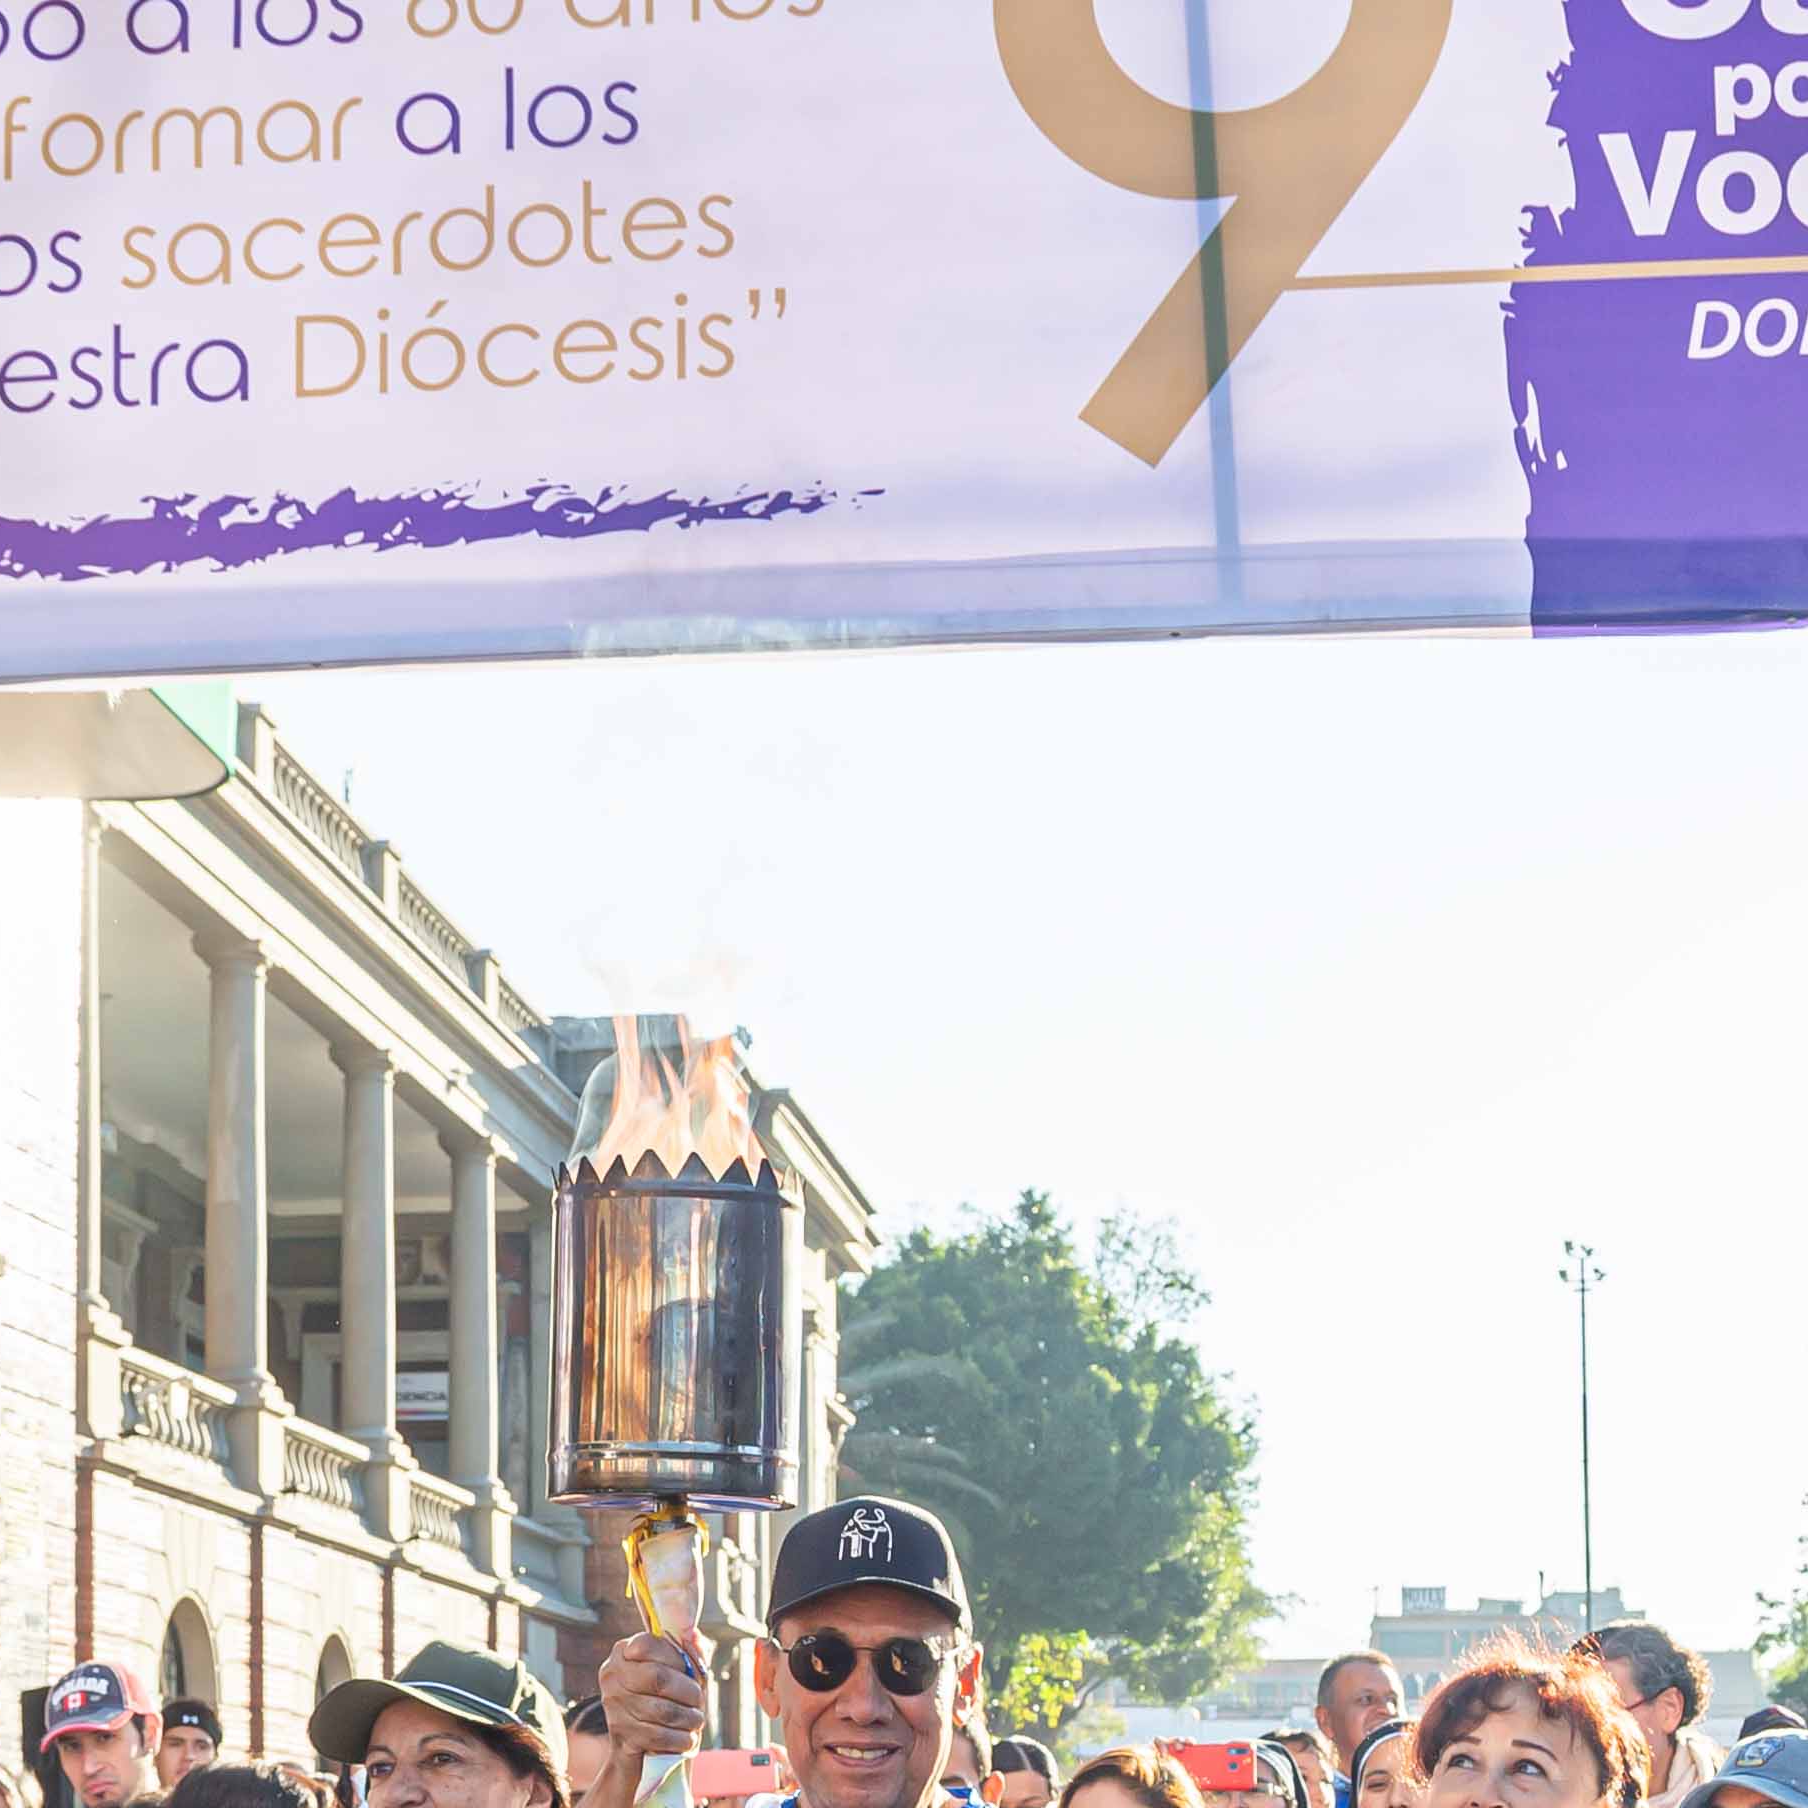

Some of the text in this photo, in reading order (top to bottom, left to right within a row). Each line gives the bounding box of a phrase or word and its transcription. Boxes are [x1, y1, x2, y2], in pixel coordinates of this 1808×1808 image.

[125, 0, 190, 55] a
[3, 96, 363, 182] formar
[395, 91, 463, 156] a
[505, 66, 641, 153] los
[120, 180, 737, 292] sacerdotes
